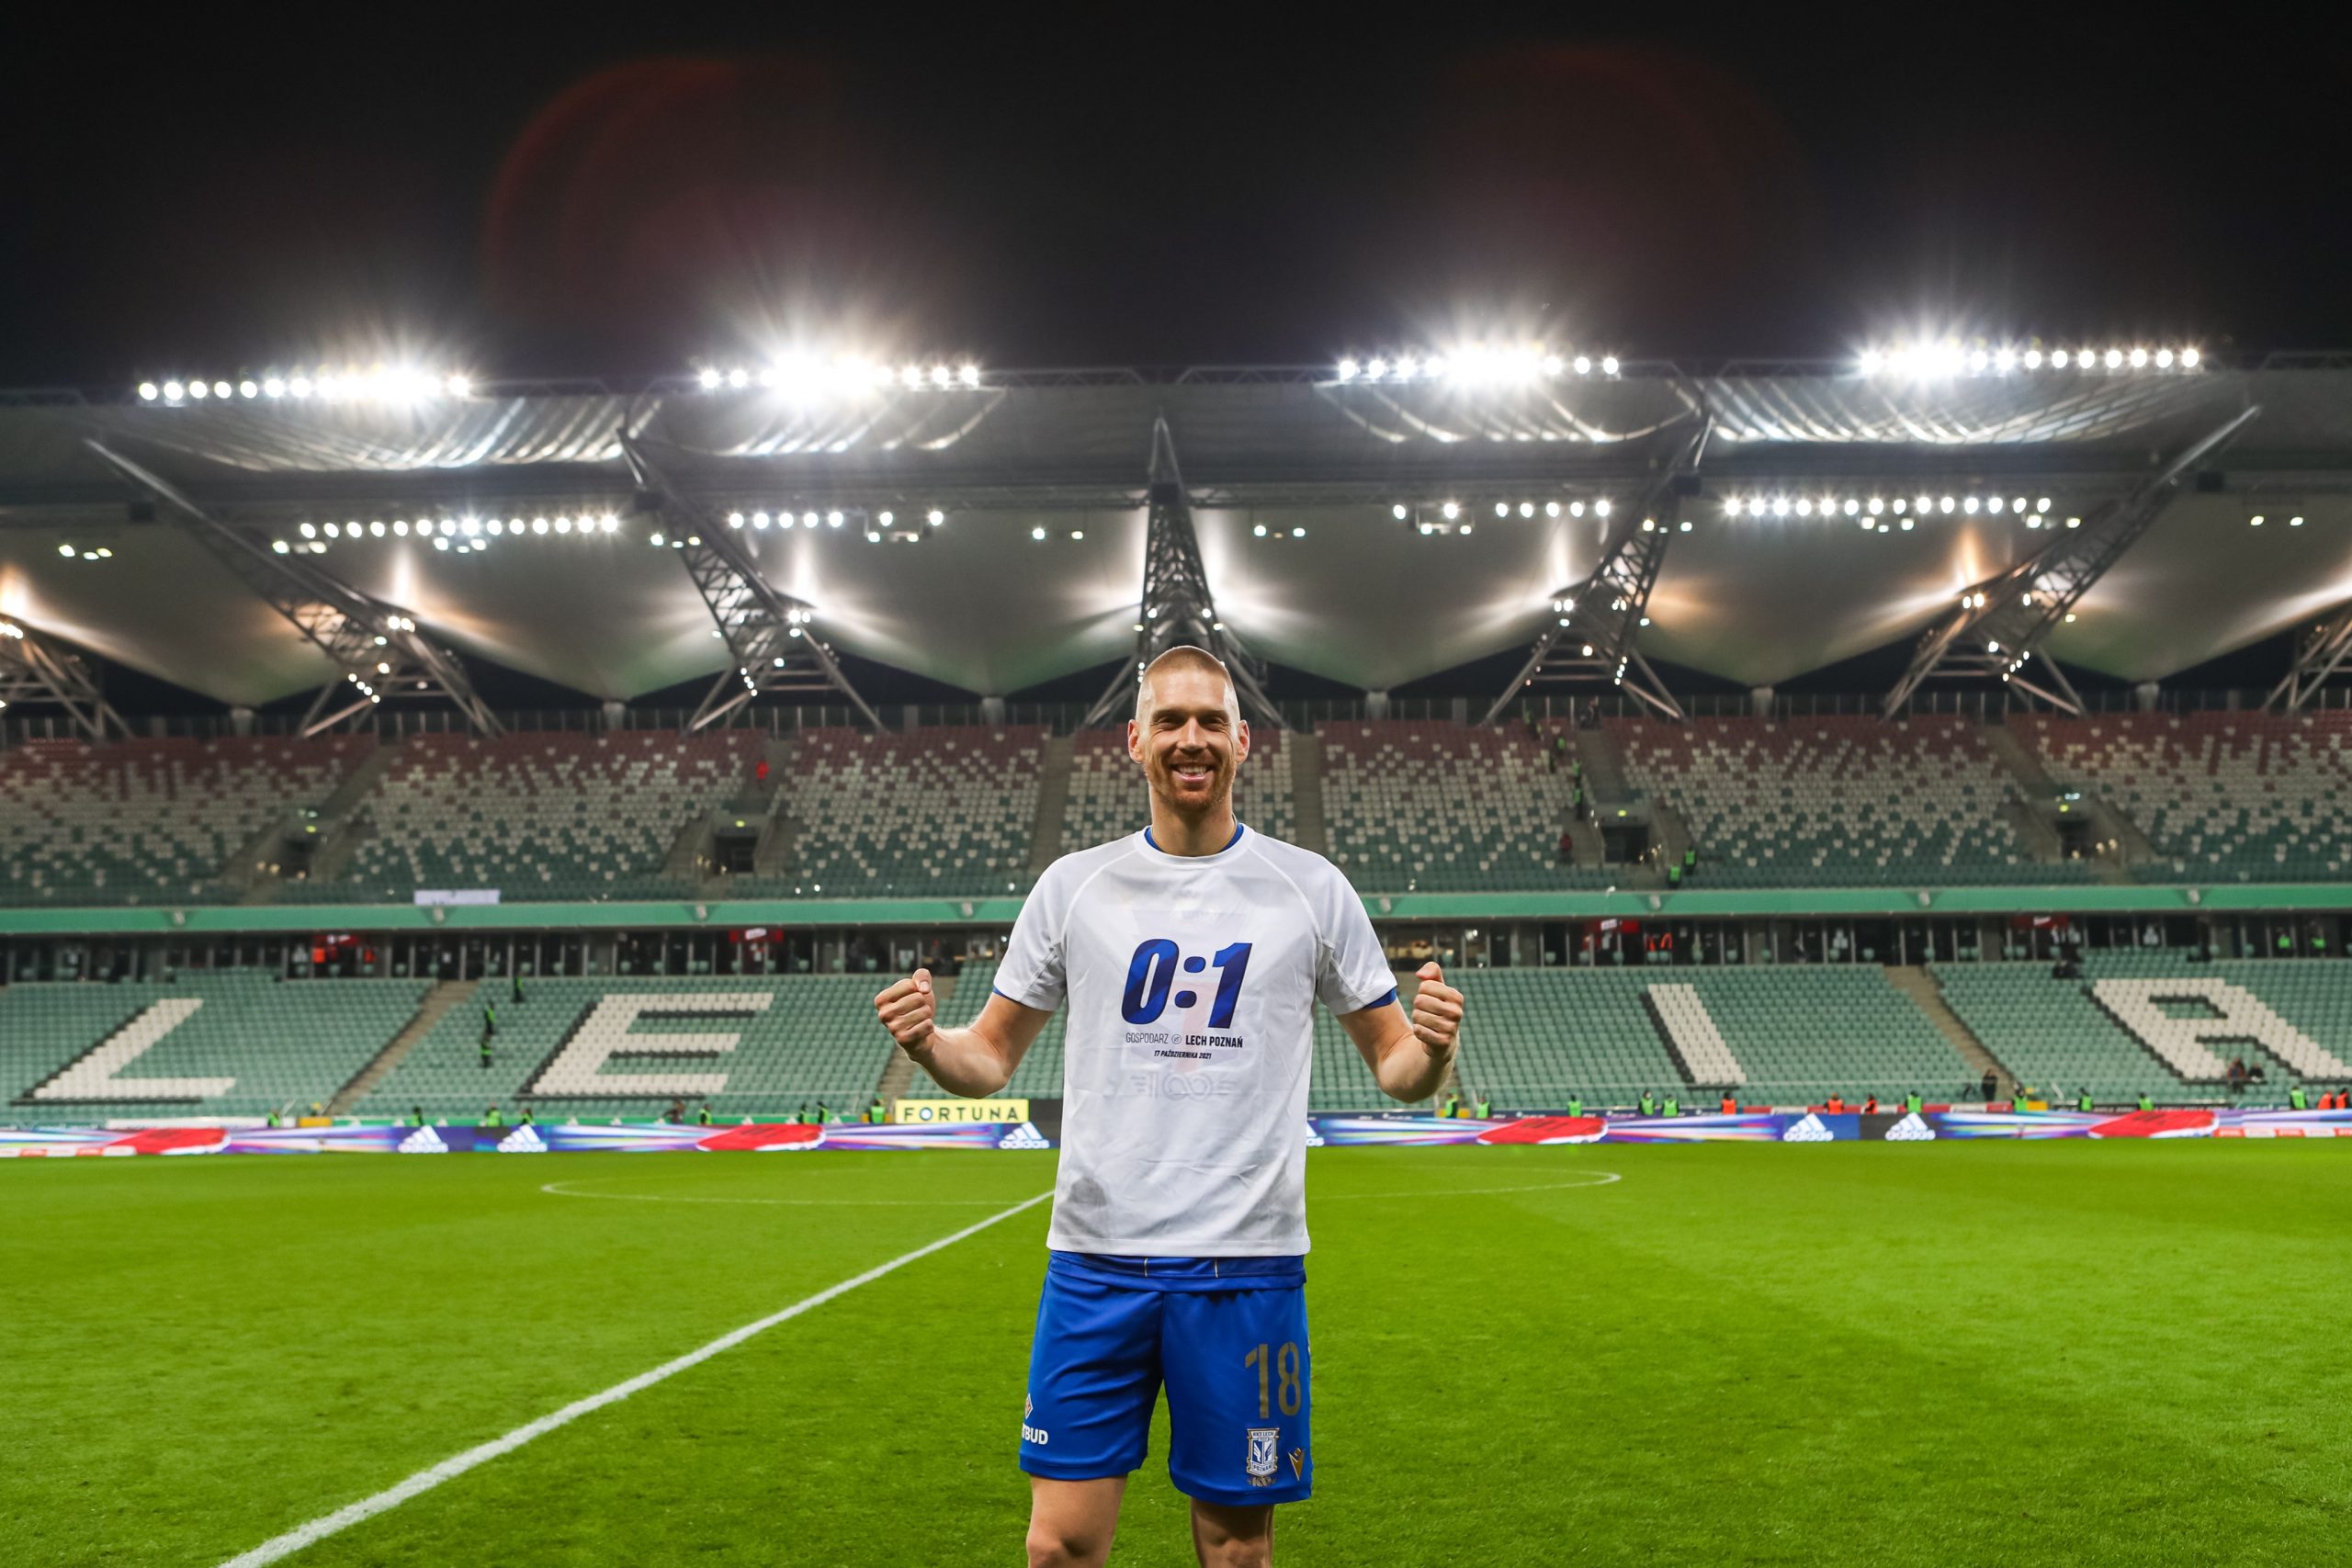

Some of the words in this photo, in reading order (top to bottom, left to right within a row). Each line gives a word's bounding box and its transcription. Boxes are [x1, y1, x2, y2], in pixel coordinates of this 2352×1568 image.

[1121, 938, 1253, 1030] 0:1
[1125, 1032, 1170, 1044] GOSPODARZ
[1185, 1034, 1207, 1046] LECH
[1209, 1035, 1243, 1048] POZNAŃ
[1160, 1049, 1198, 1059] PAŹDZIERNIKA
[1199, 1052, 1213, 1060] 2021
[904, 1107, 1019, 1122] FORTUNA
[1245, 1341, 1301, 1419] 18
